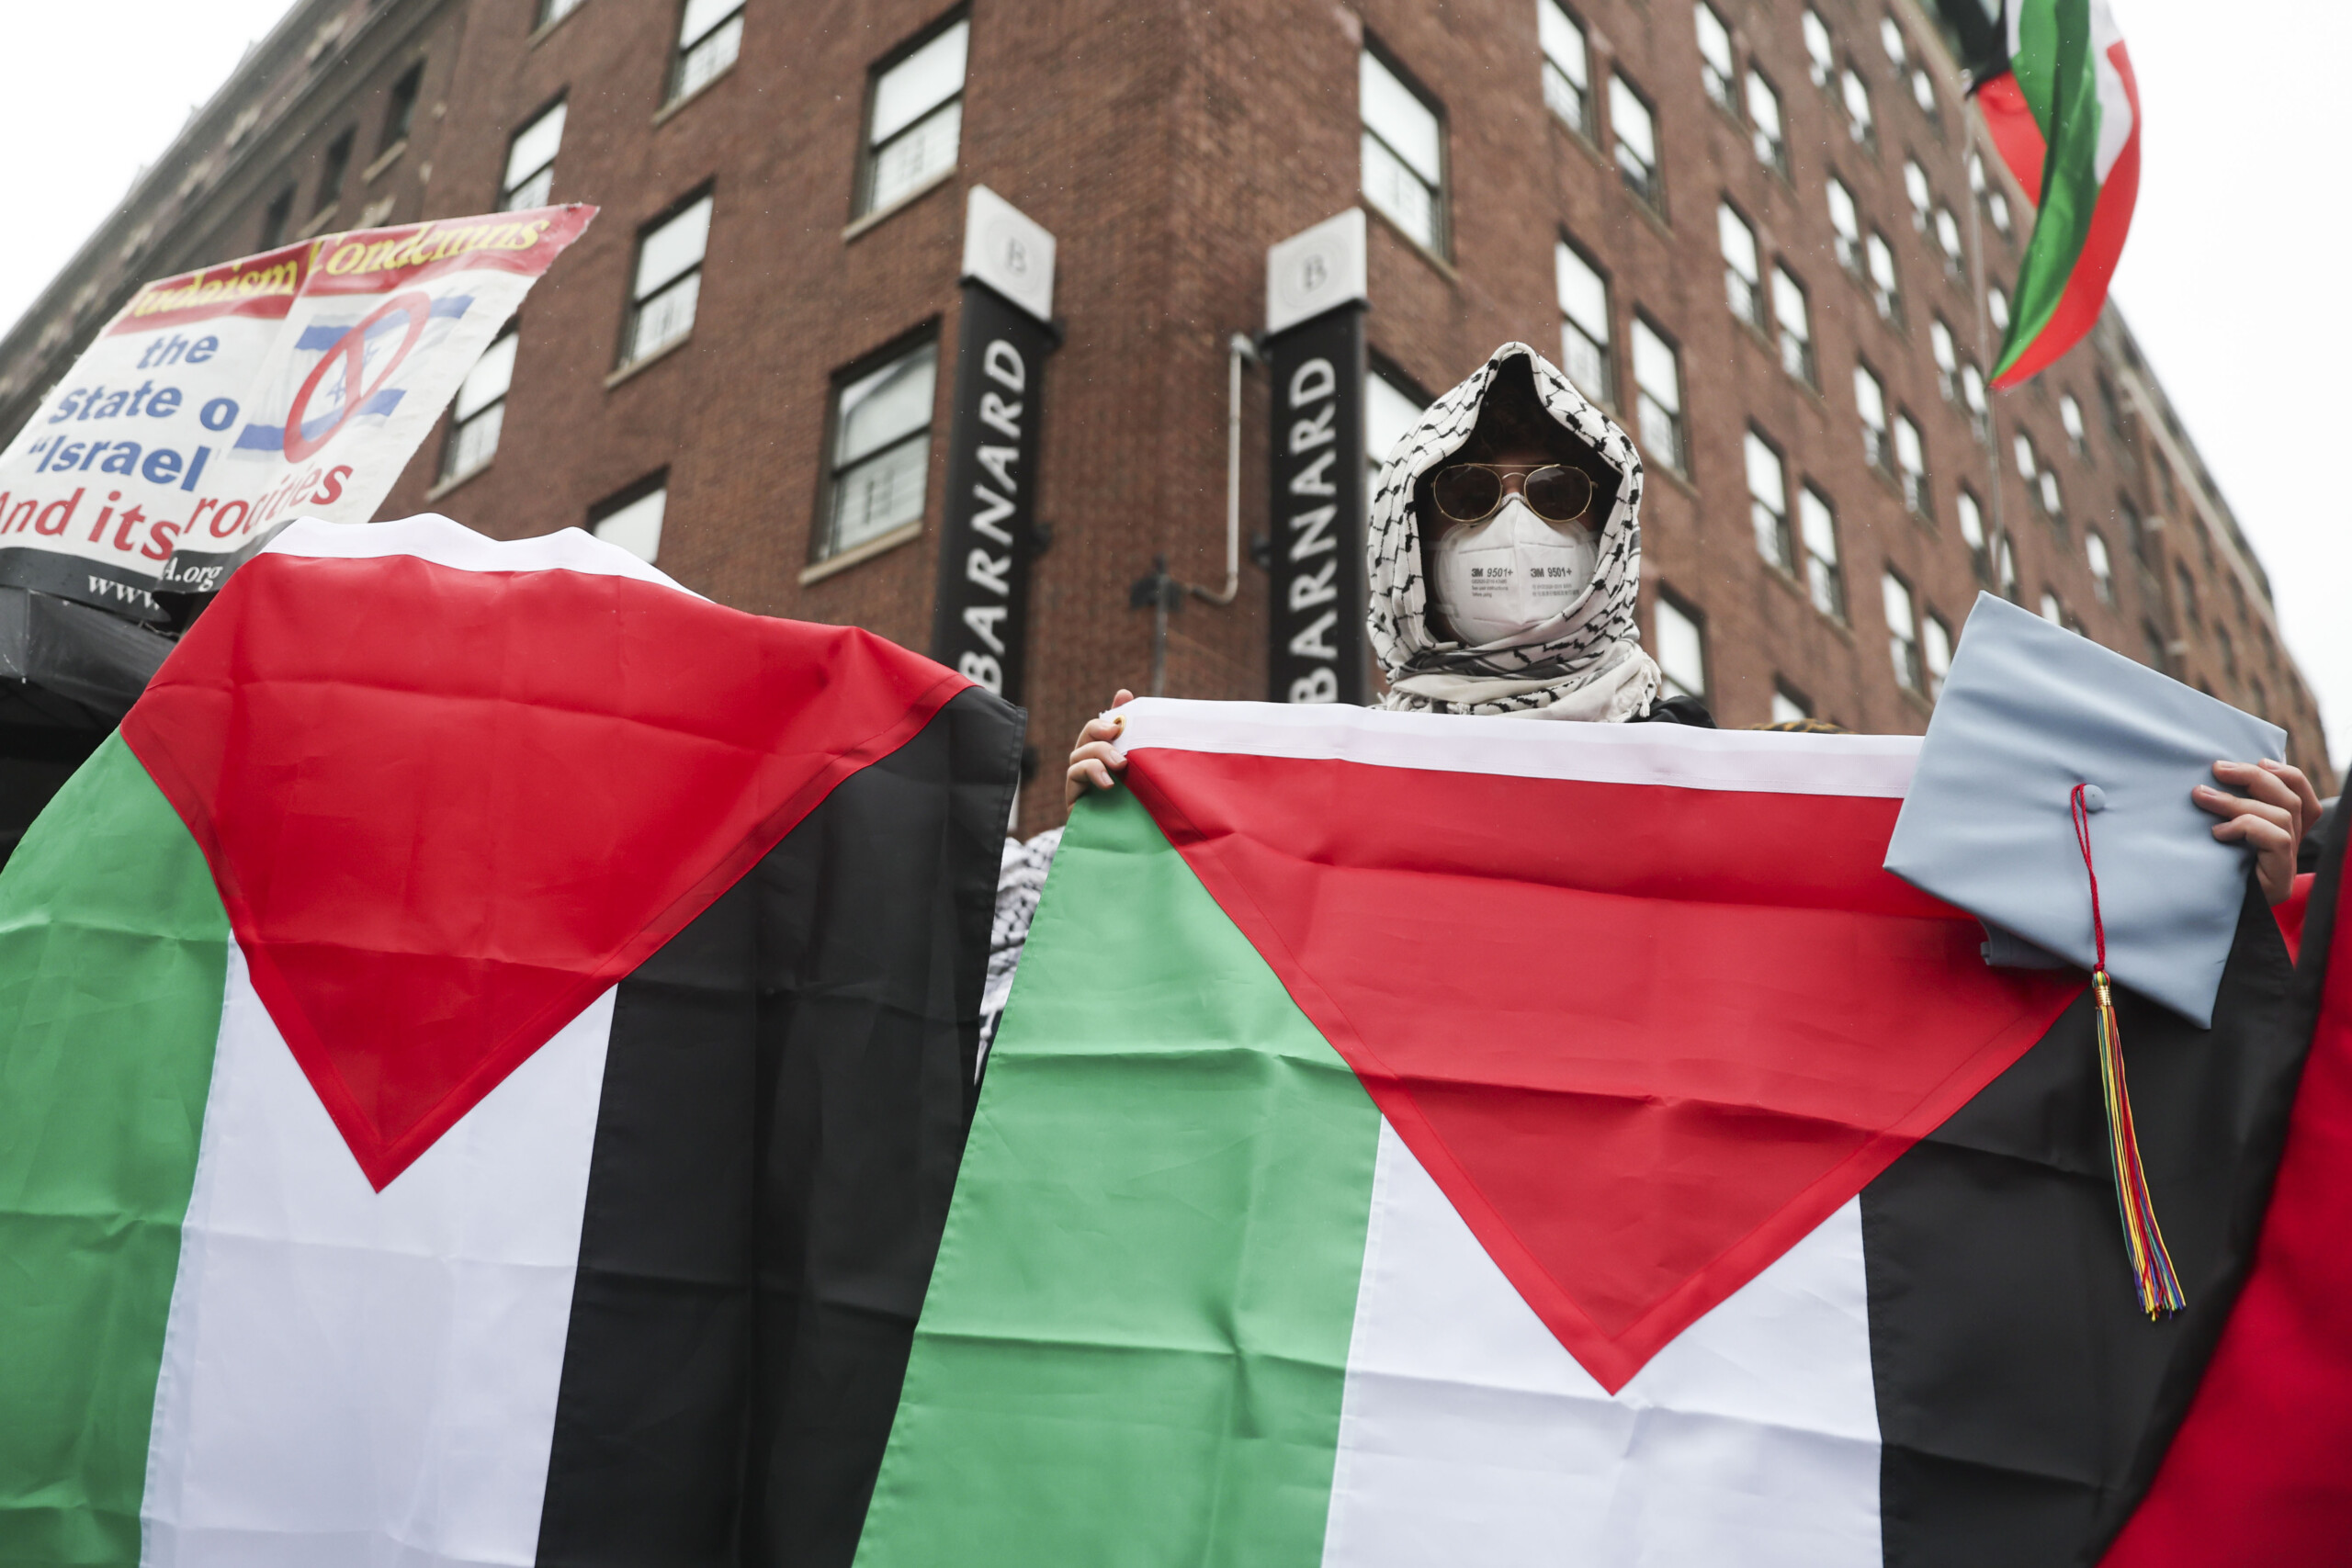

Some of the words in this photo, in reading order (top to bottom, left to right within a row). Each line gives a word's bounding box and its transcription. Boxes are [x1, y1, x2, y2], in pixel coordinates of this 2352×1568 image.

[134, 259, 297, 318] udaism
[137, 333, 218, 369] the
[48, 380, 183, 424] state
[199, 397, 240, 432] o
[87, 491, 182, 561] its
[959, 339, 1026, 695] BARNARD
[1288, 357, 1337, 704] BARNARD
[1471, 568, 1484, 578] 3M
[1487, 567, 1514, 578] 9501+
[1530, 568, 1545, 578] 3M
[1547, 566, 1573, 578] 9501+
